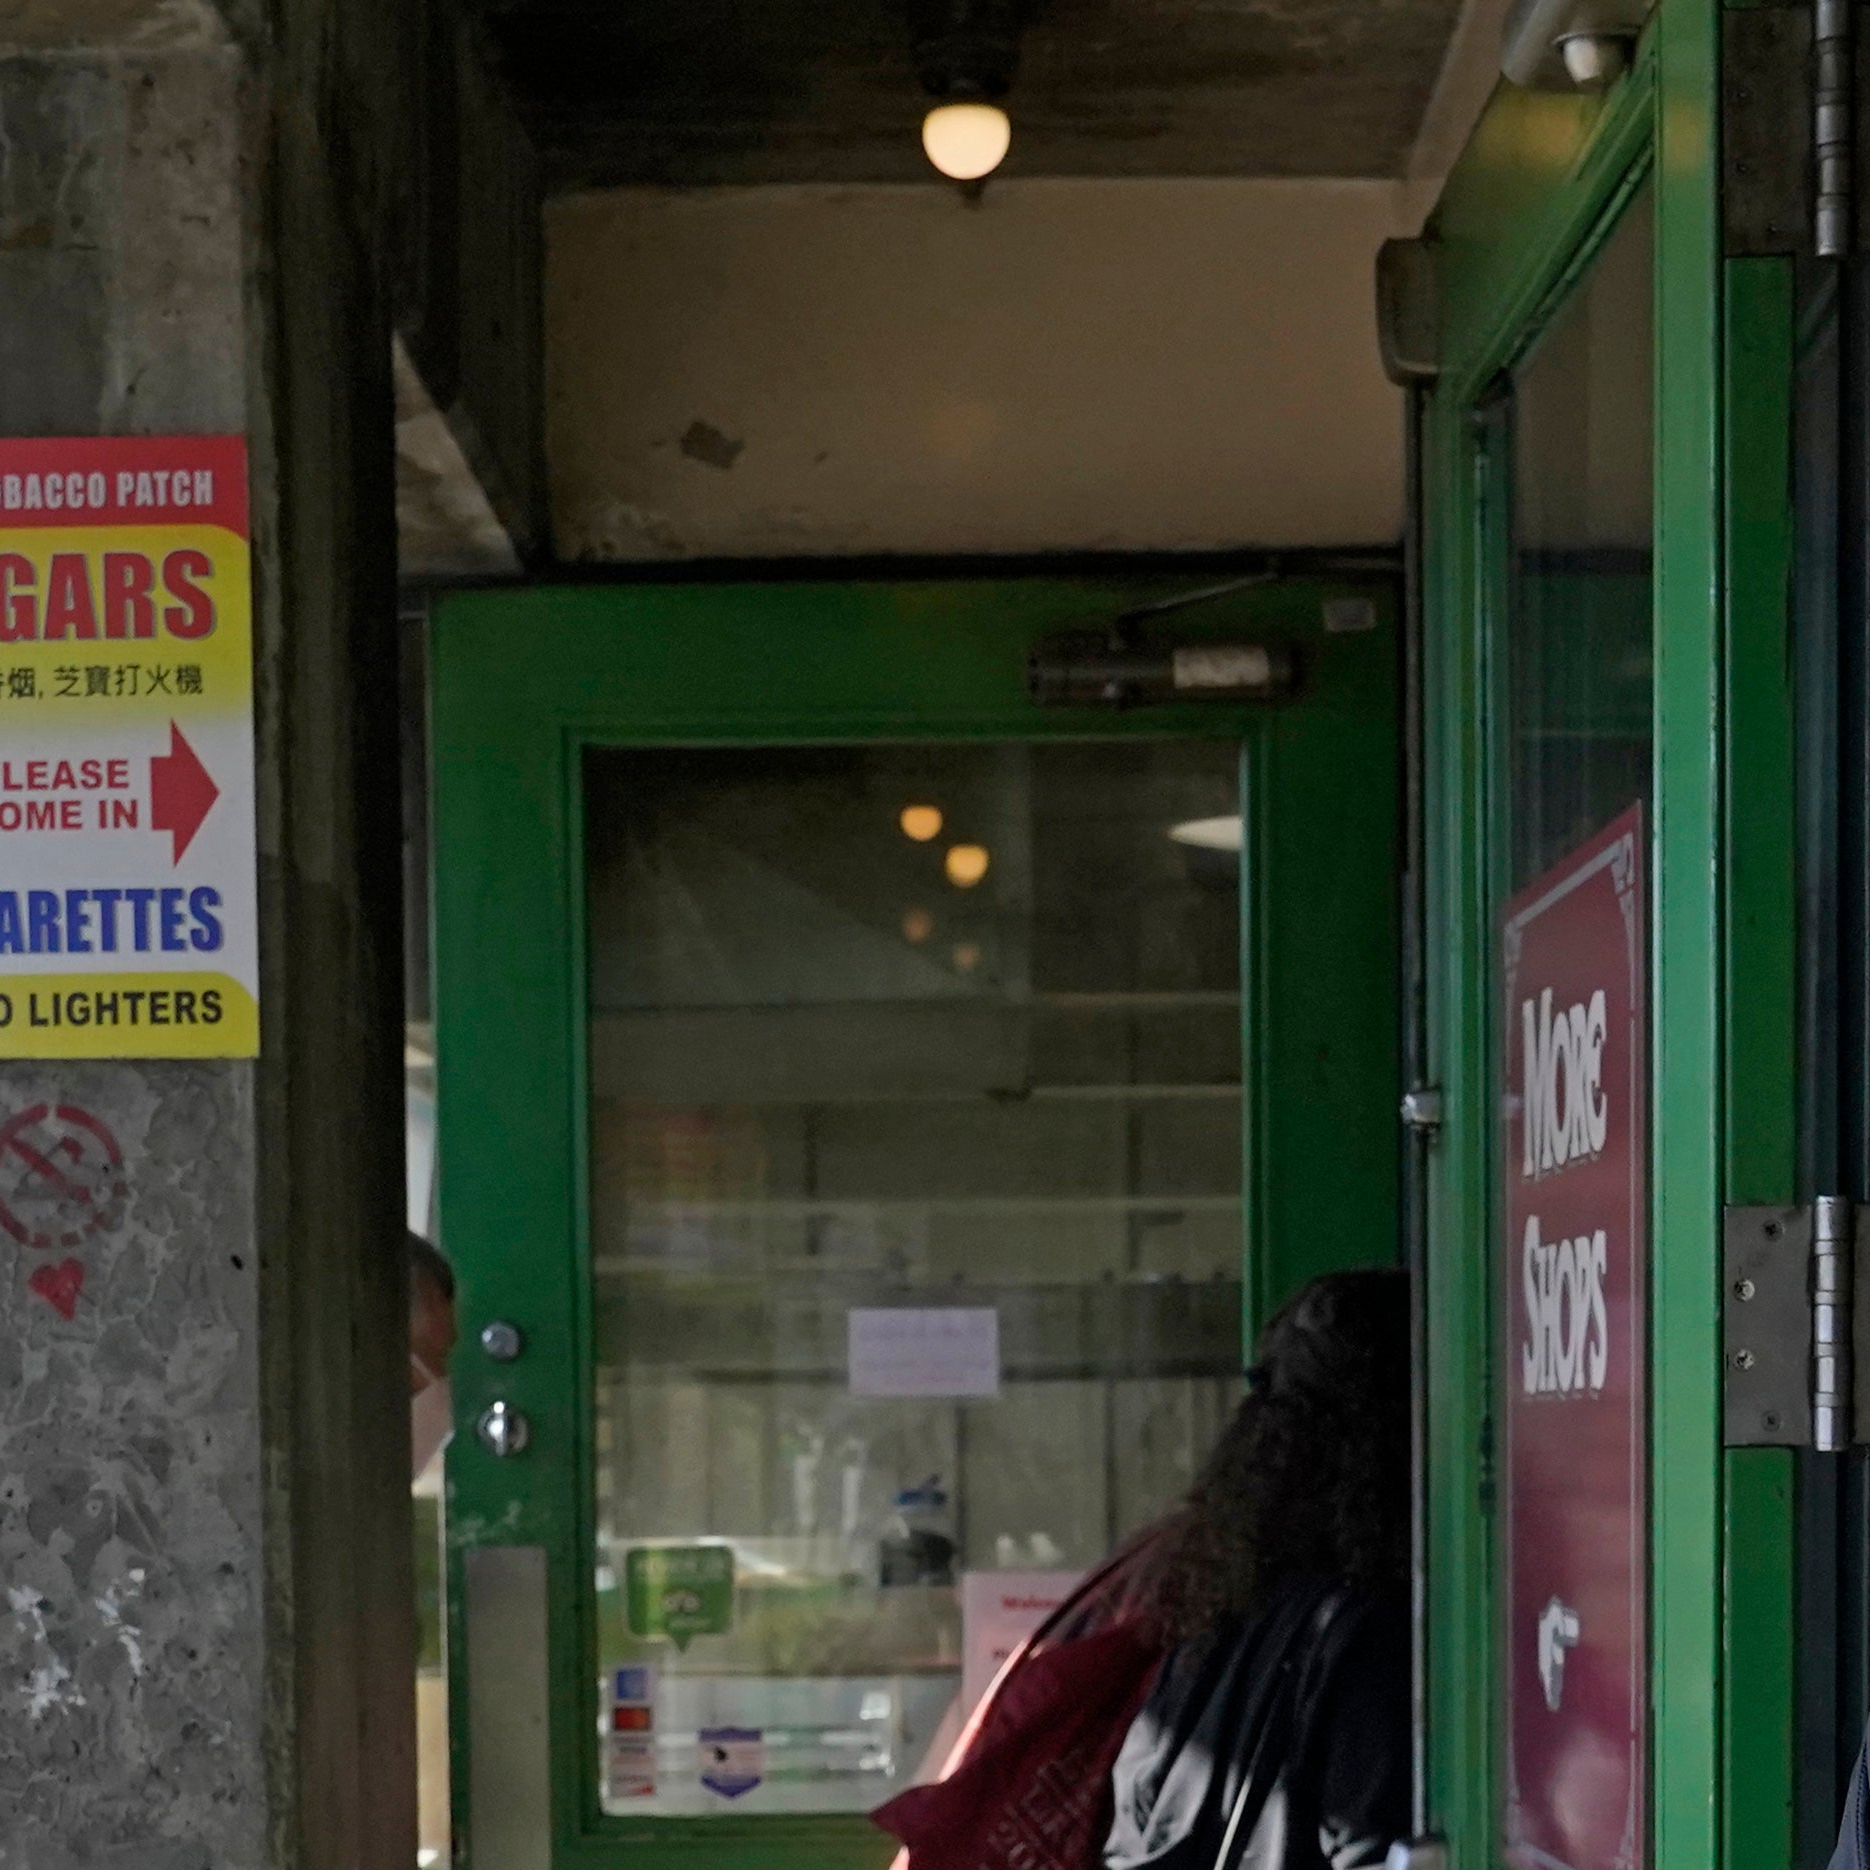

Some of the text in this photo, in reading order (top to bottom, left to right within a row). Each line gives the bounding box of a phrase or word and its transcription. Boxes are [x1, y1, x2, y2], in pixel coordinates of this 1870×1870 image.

[116, 470, 214, 508] PATCH
[98, 799, 138, 830] IN
[29, 989, 224, 1027] LIGHTERS
